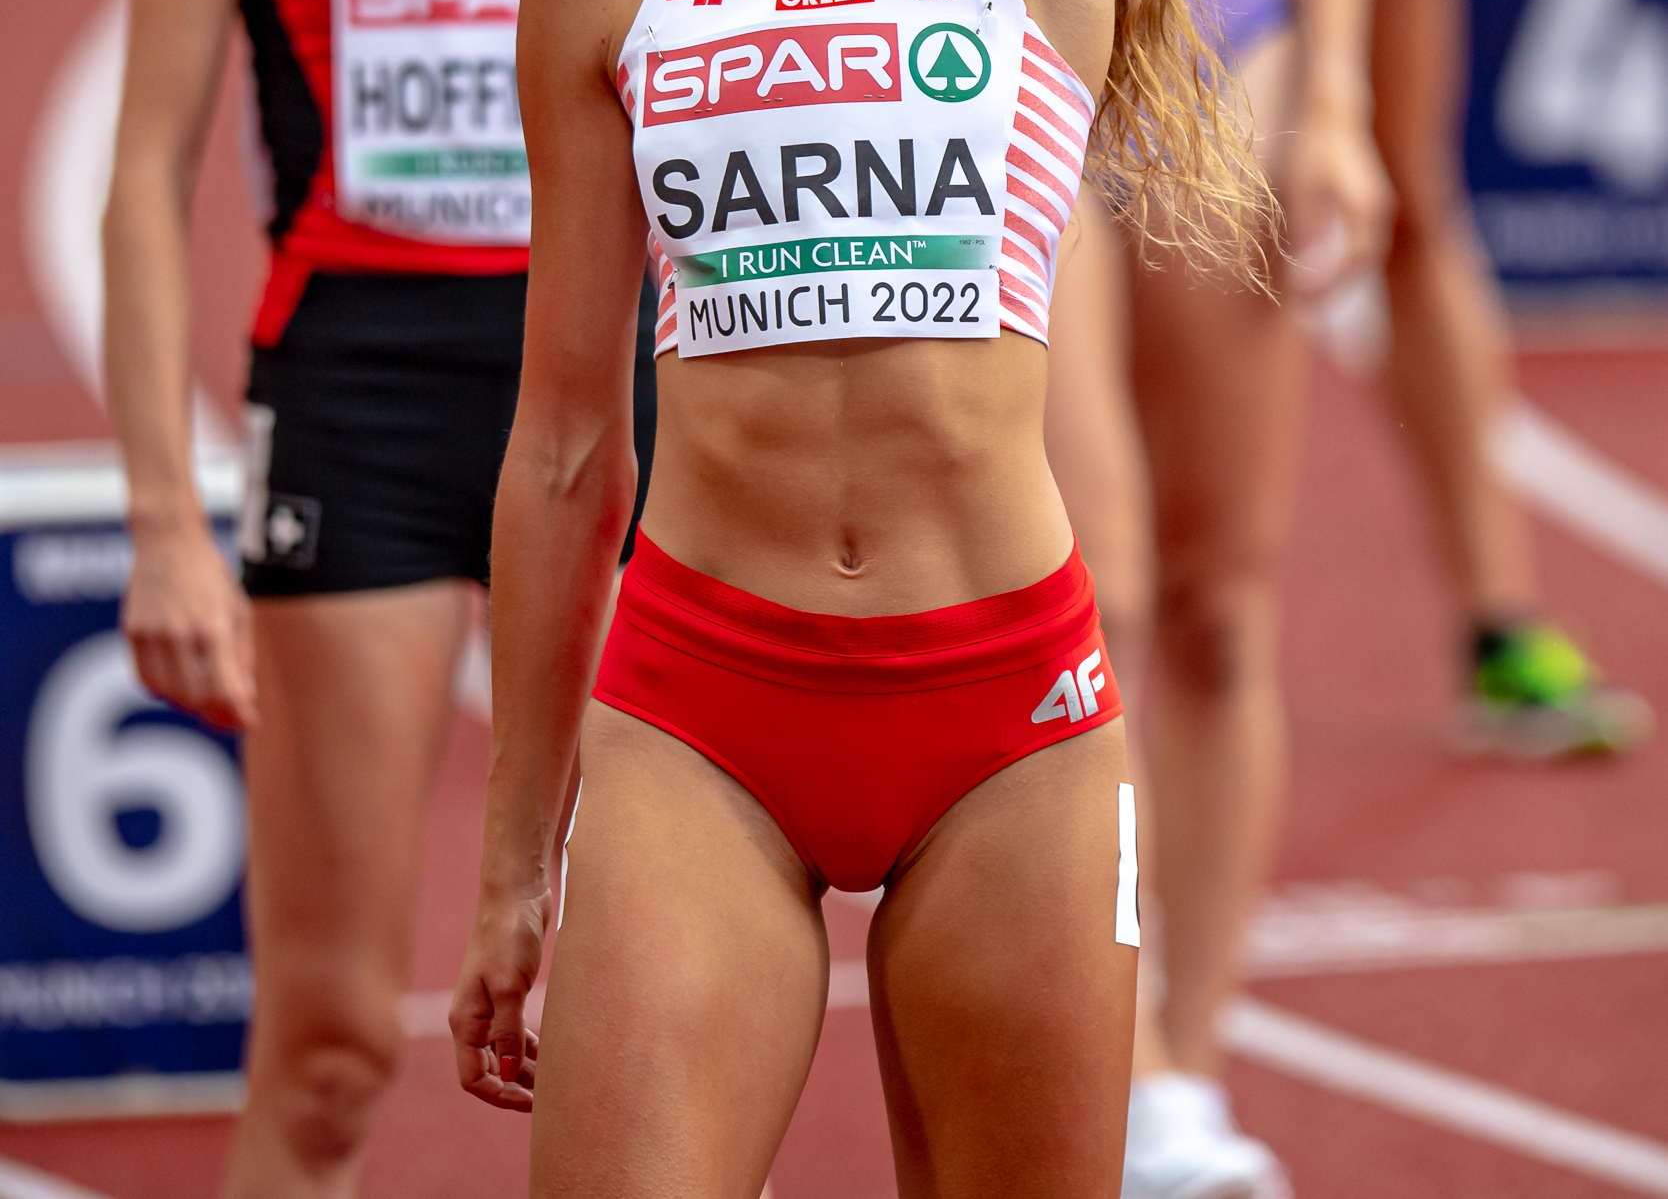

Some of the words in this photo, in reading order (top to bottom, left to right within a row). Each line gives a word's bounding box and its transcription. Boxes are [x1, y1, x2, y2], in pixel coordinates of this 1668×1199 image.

[350, 58, 520, 134] HOFF
[650, 34, 893, 114] SPAR
[652, 137, 996, 240] SARNA
[721, 253, 728, 278] I
[738, 244, 801, 276] RUN
[689, 282, 850, 342] MUNICH
[870, 281, 981, 323] 2022
[24, 628, 249, 935] 6
